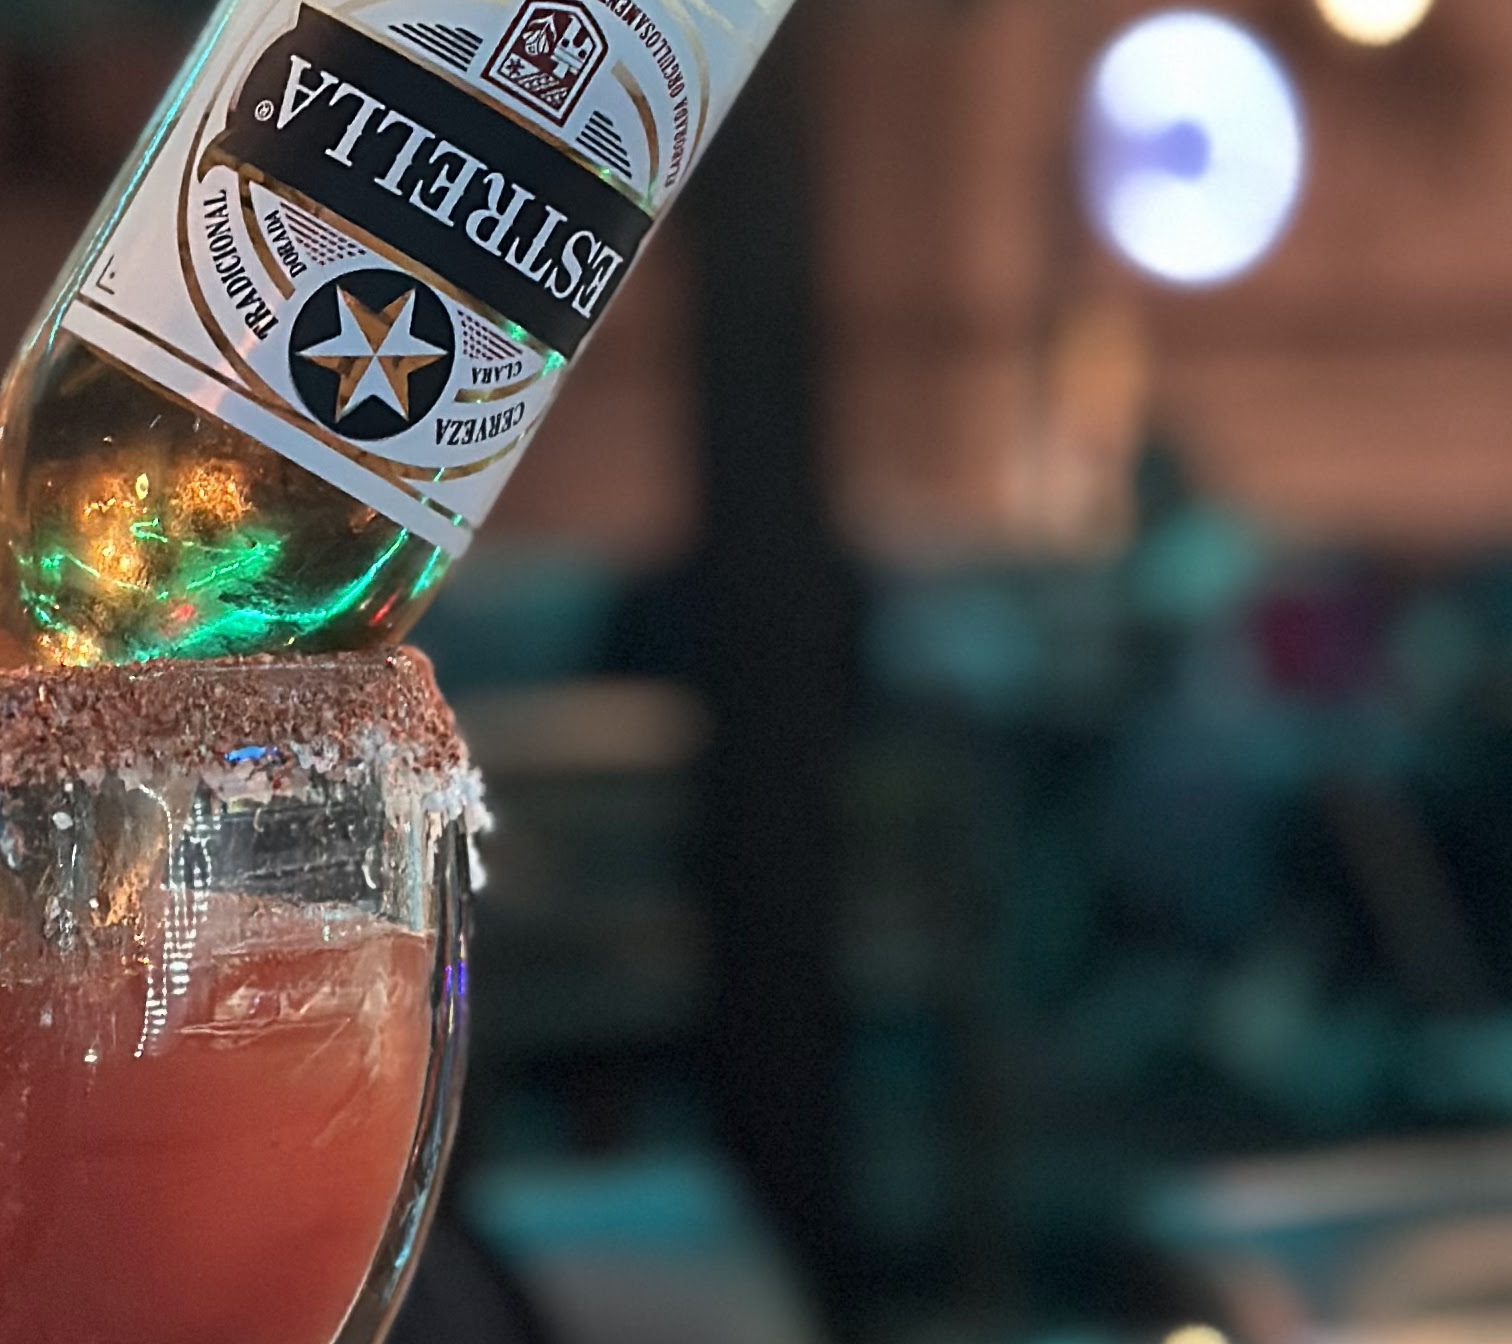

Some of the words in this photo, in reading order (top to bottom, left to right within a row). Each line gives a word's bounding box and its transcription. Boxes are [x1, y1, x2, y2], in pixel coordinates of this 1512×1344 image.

[665, 96, 689, 188] ELABORADA
[203, 189, 279, 340] TRADICIONAL
[264, 209, 307, 278] DORADA
[471, 361, 523, 385] CLARA
[436, 402, 525, 445] CERVEZA
